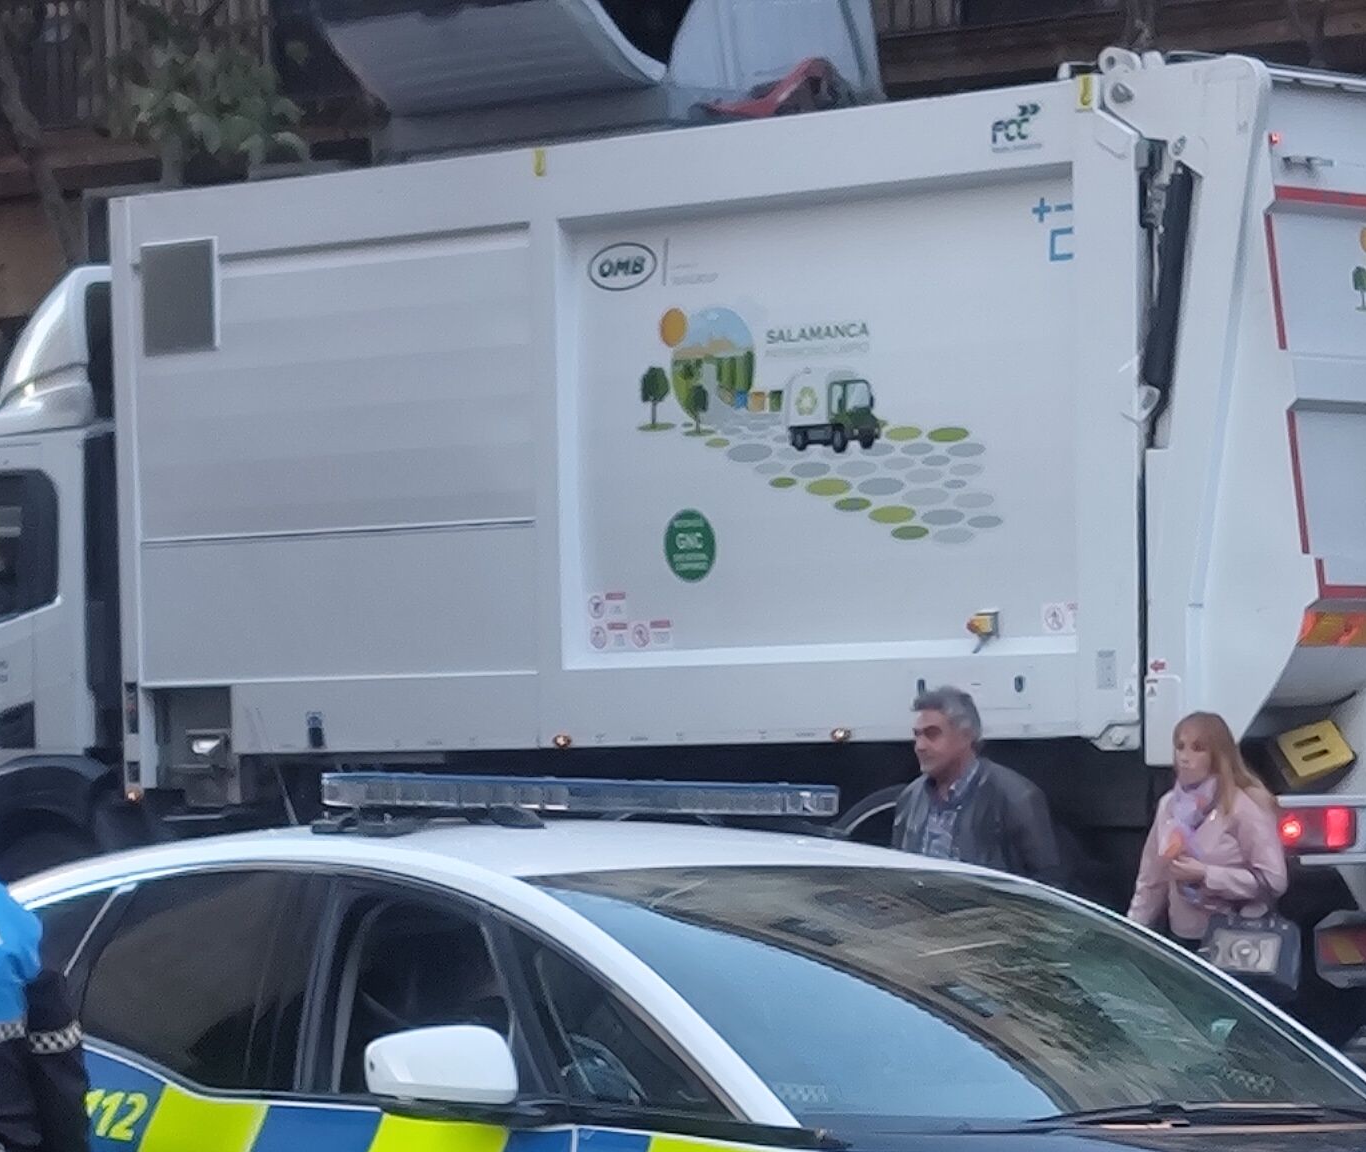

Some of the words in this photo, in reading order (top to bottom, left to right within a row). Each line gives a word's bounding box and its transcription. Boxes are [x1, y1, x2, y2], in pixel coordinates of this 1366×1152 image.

[992, 117, 1030, 144] FCC
[598, 256, 646, 278] OMB
[766, 322, 870, 345] SALAMANCA
